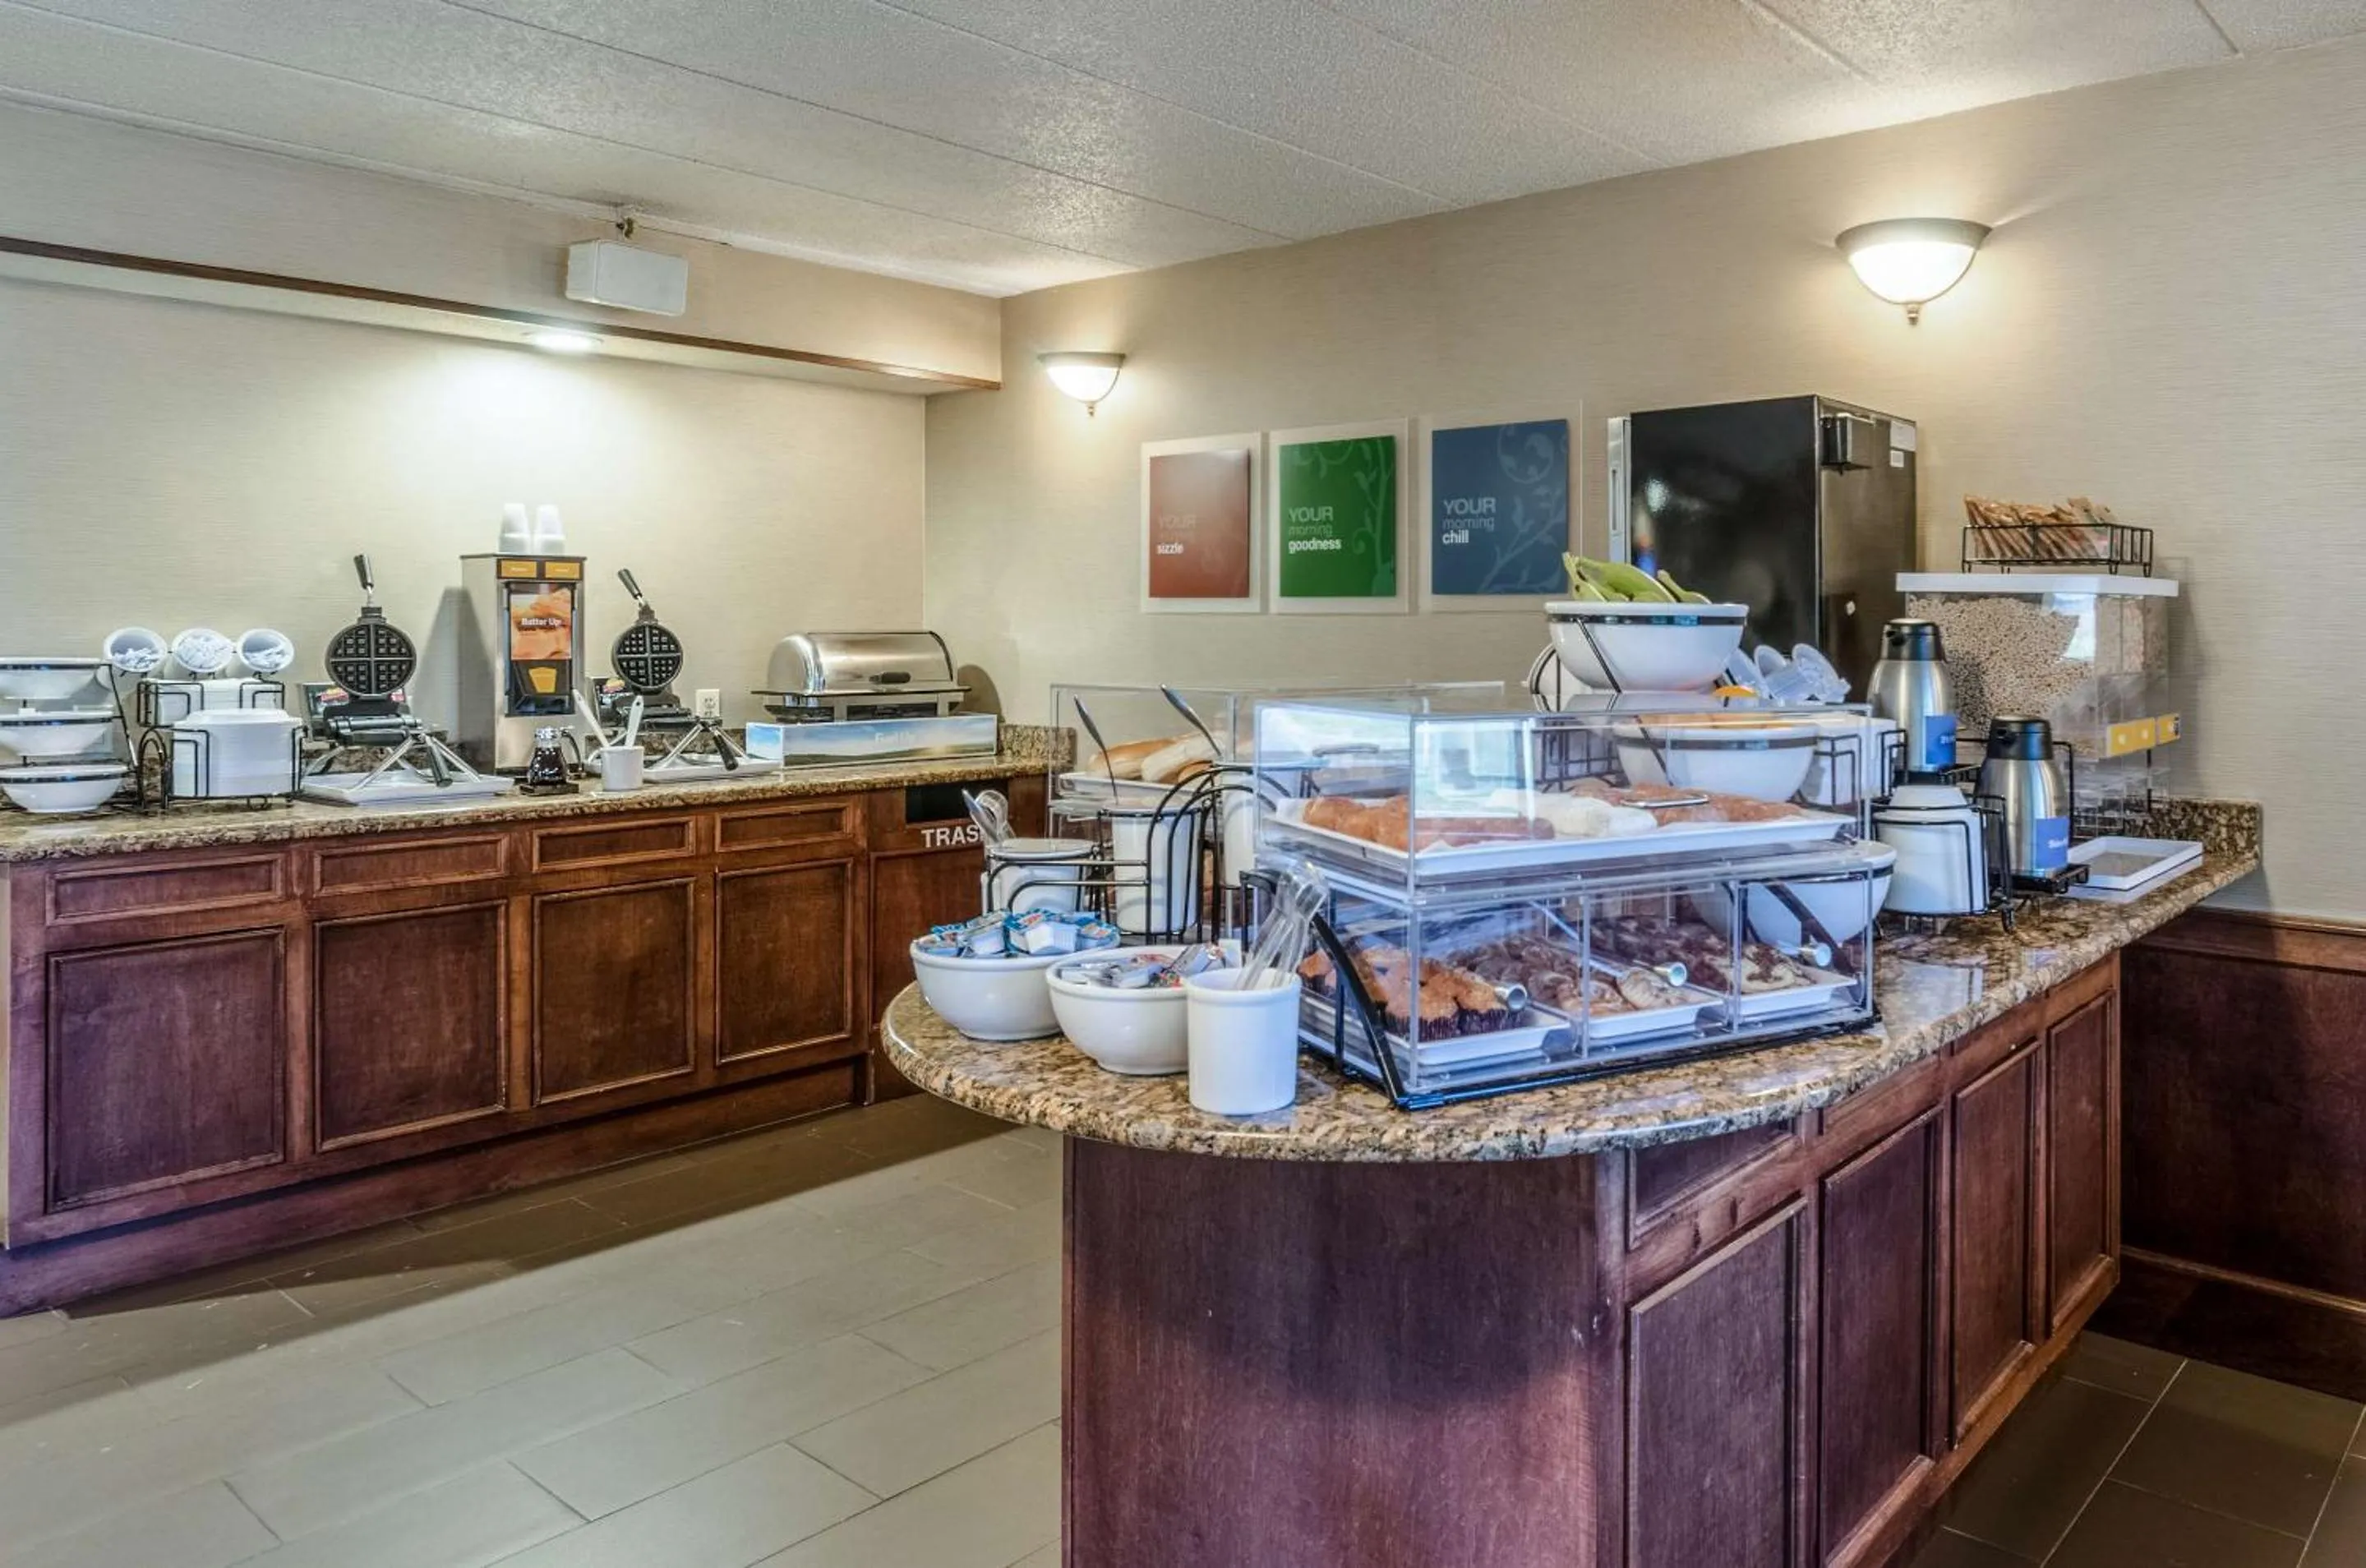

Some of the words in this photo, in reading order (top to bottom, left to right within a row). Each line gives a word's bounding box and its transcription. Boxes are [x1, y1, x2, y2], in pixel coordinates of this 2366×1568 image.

[1288, 506, 1334, 523] YOUR
[1443, 497, 1497, 515] YOUR
[1442, 516, 1494, 533] morning
[1442, 529, 1469, 545] chill
[1156, 542, 1184, 556] sizzle
[1288, 537, 1342, 555] goodness
[920, 824, 984, 848] TRAS
